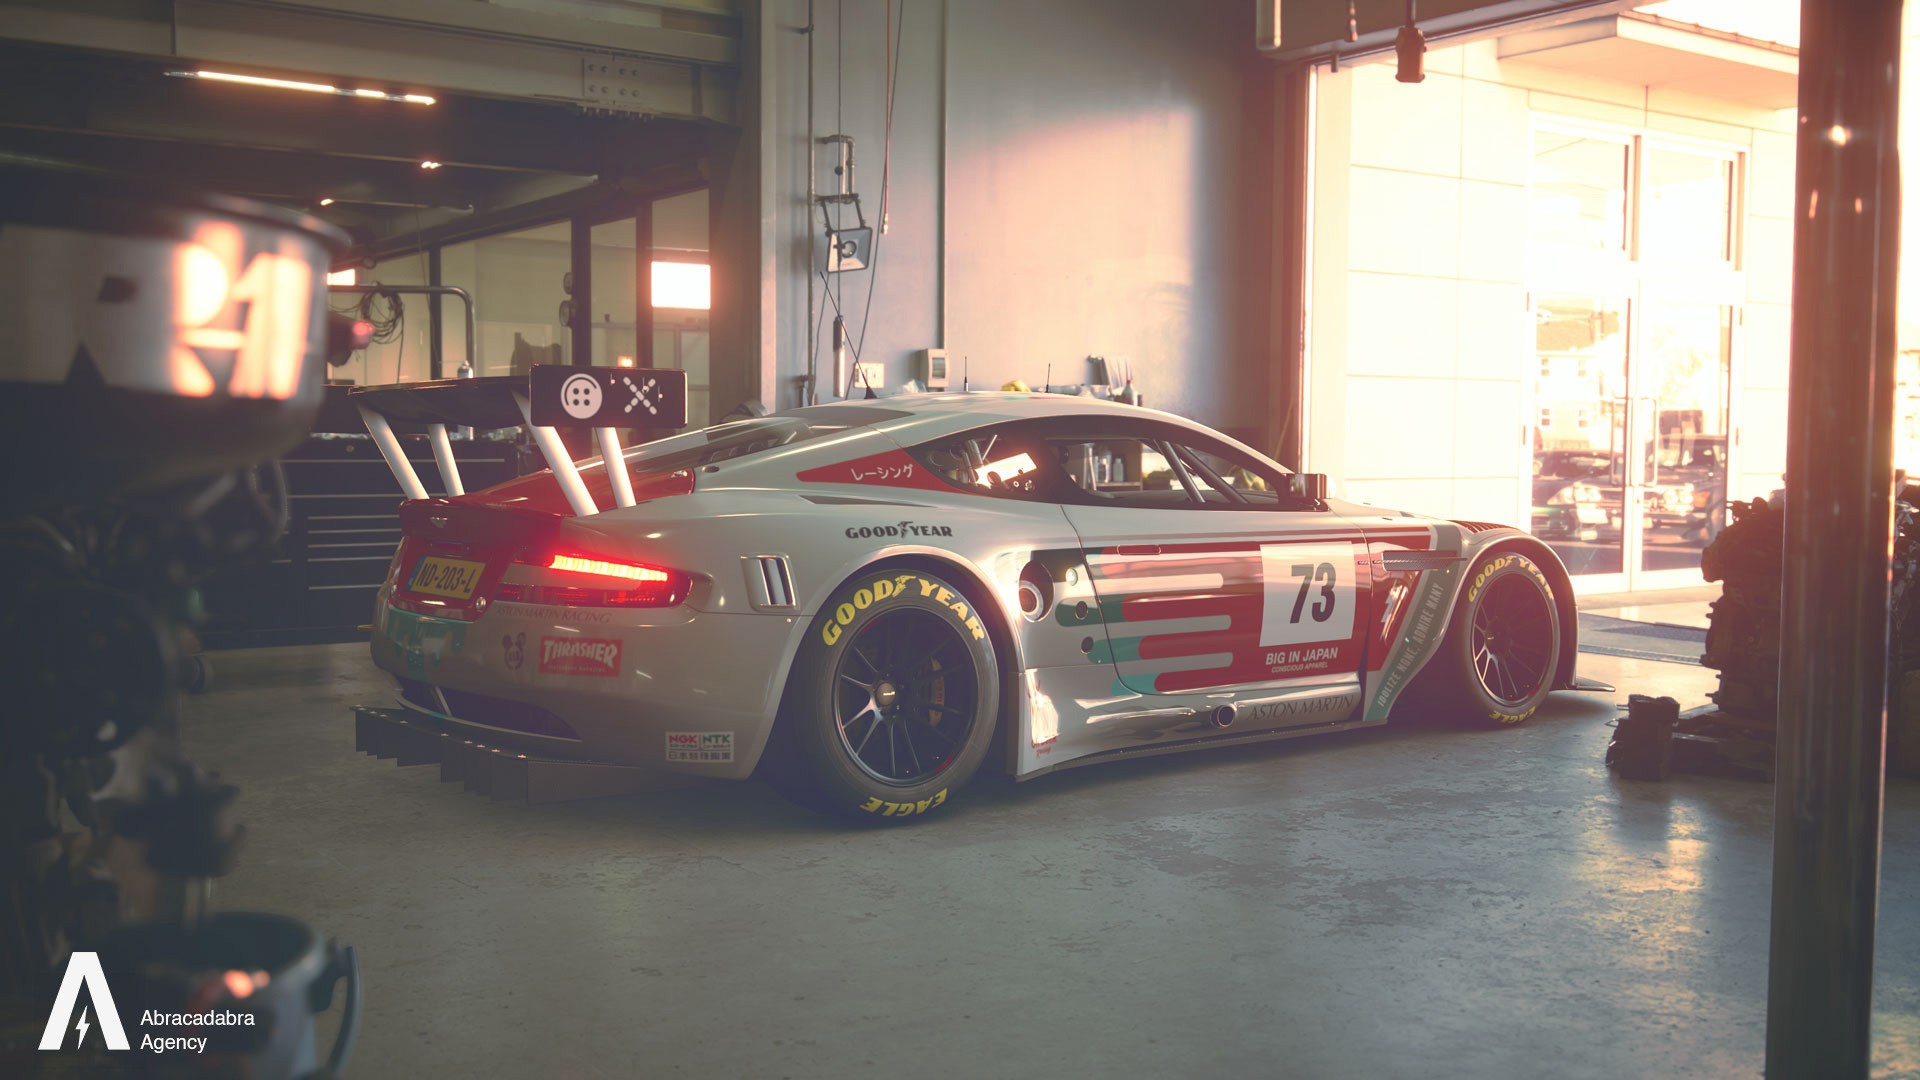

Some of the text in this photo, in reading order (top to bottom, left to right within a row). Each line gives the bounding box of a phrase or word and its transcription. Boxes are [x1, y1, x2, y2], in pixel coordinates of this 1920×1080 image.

[850, 464, 914, 480] レーシング
[416, 562, 476, 594] ND-203-L
[1289, 562, 1337, 624] 73
[561, 608, 613, 624] RACING
[543, 639, 618, 669] THRASHER
[1377, 671, 1401, 707] IDOLIZE
[1412, 609, 1435, 645] ADMIRE
[1425, 582, 1445, 611] MANY
[1265, 647, 1339, 665] BIG IN JAPAN
[1271, 661, 1329, 674] CONSCIOUS APPAREL
[1250, 695, 1354, 720] ASTON MARTIN
[1489, 705, 1537, 724] EAGLE
[669, 734, 731, 744] NGK NTK
[858, 787, 948, 817] EAGLE
